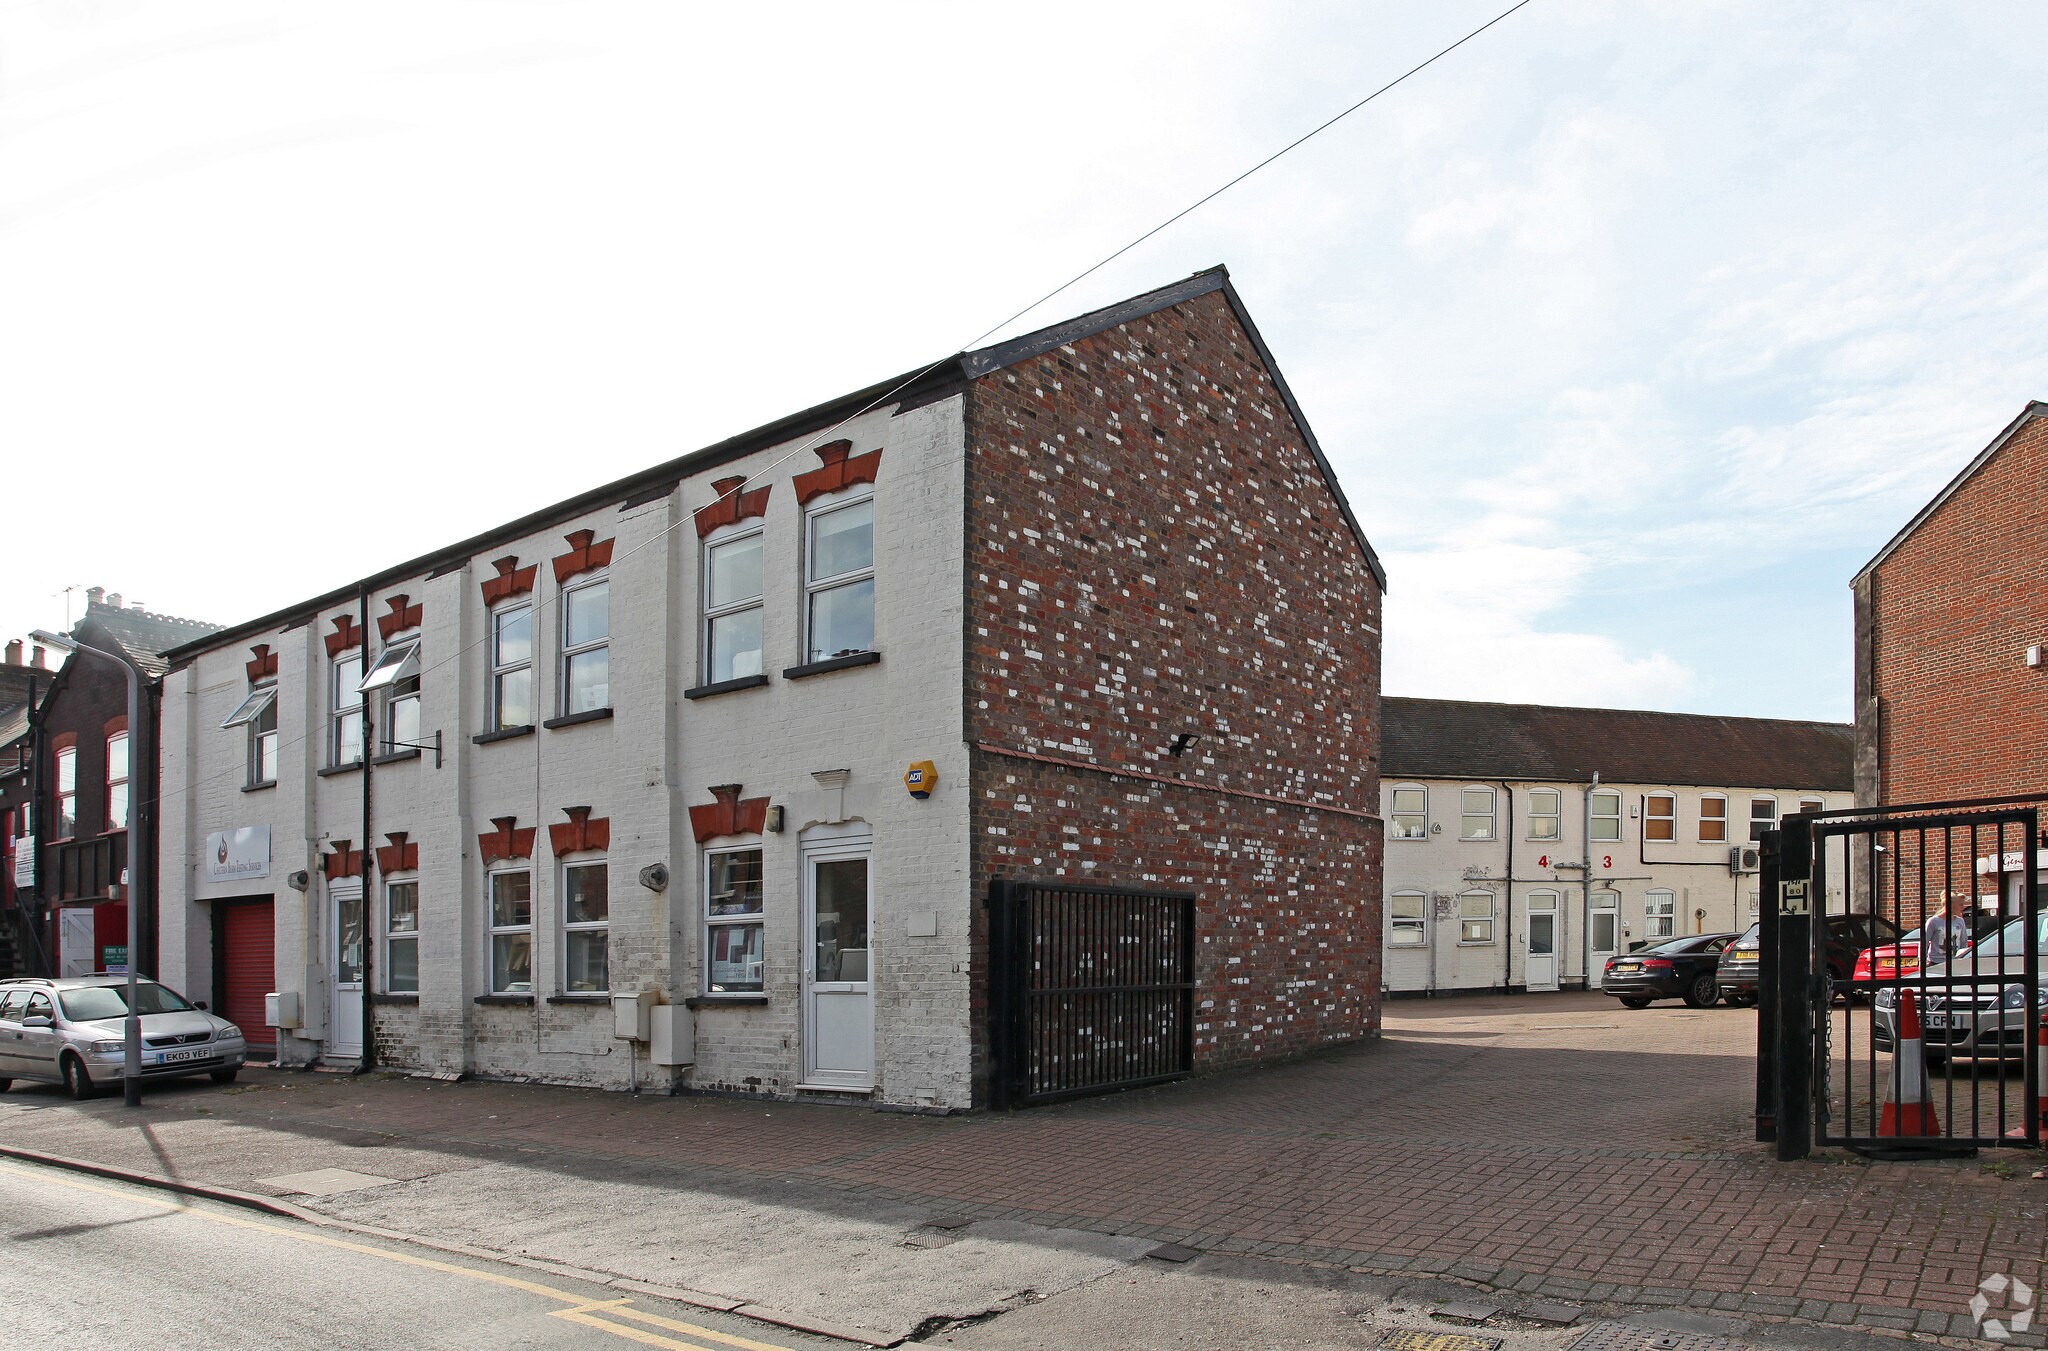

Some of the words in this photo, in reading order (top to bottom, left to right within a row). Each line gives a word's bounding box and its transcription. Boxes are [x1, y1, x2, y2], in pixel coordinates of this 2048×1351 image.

[909, 773, 922, 781] ADT
[1538, 855, 1548, 868] 4
[1603, 855, 1612, 869] 3
[166, 1052, 190, 1061] EK03
[192, 1050, 209, 1058] VEF
